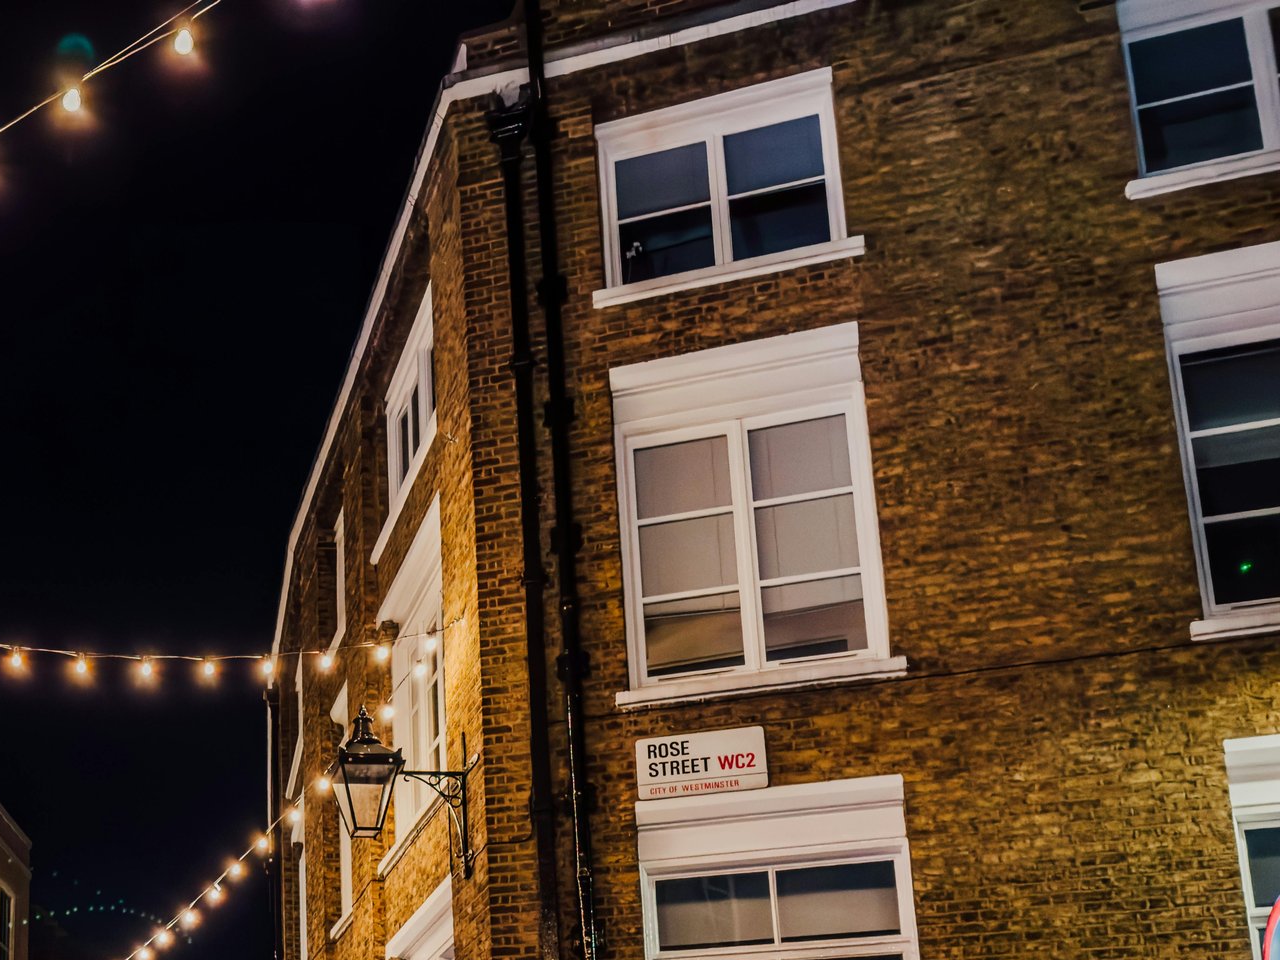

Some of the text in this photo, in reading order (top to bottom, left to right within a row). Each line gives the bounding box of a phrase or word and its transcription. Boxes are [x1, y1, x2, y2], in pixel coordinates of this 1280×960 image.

[647, 740, 690, 759] ROSE
[648, 752, 756, 778] STREET WC2
[649, 779, 740, 796] CITY OF WESTMINSTER
